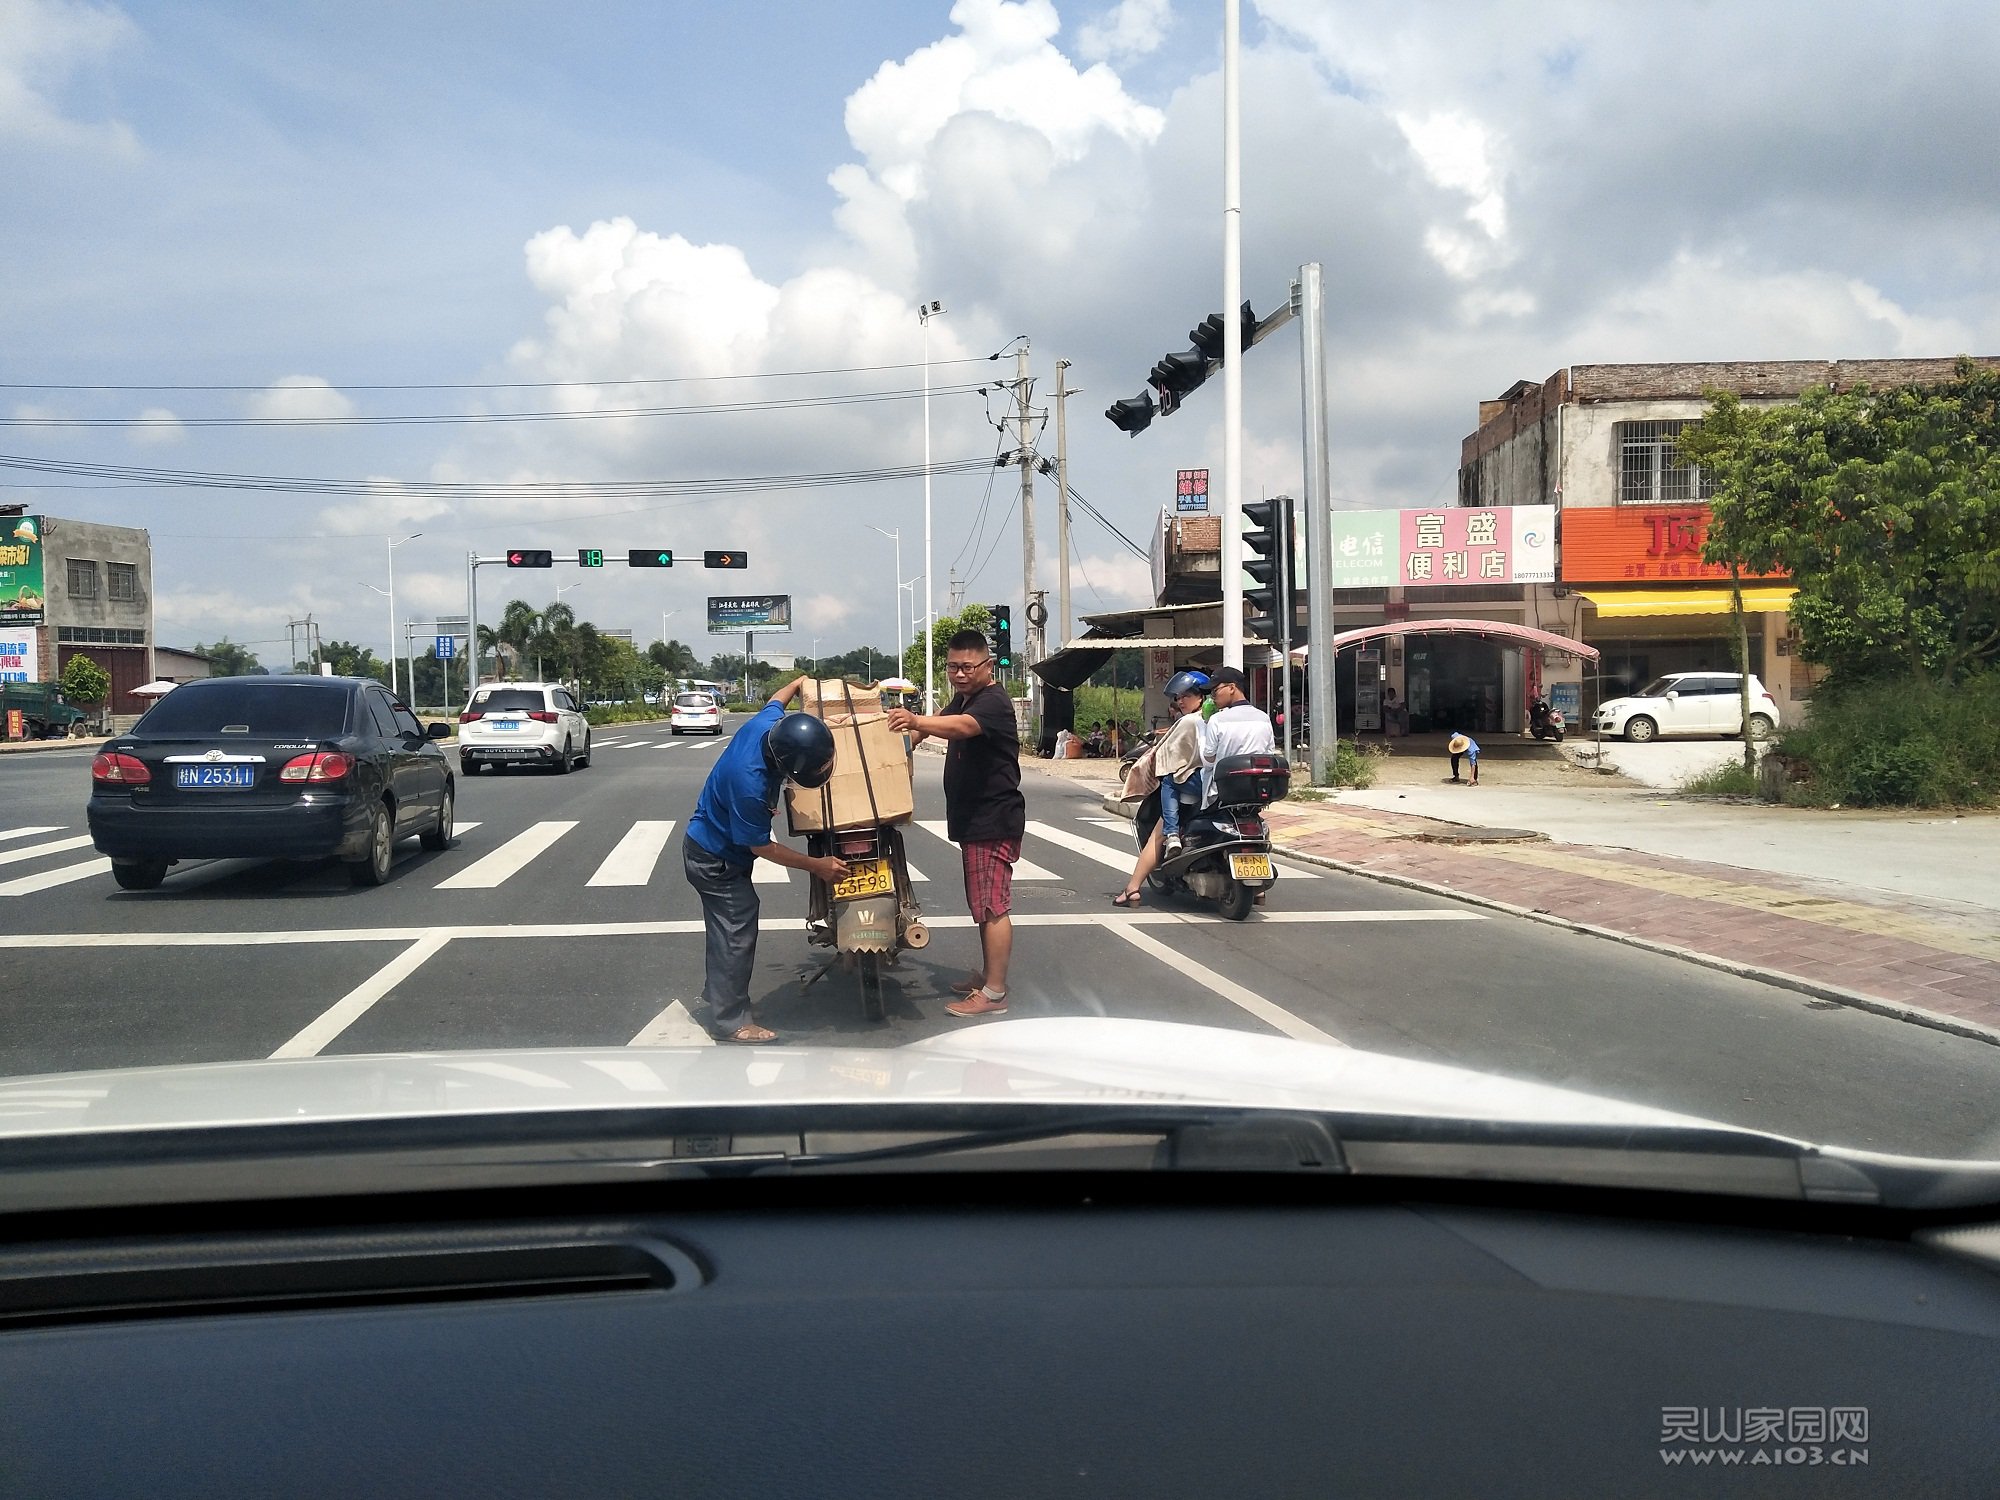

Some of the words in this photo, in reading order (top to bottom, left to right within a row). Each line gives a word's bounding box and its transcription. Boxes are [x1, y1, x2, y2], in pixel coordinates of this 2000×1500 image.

[1178, 479, 1208, 495] 维修
[1415, 511, 1498, 549] 富盛
[1340, 531, 1385, 556] 电信
[587, 550, 602, 566] 18
[1406, 550, 1506, 580] 便利店
[1237, 866, 1269, 877] 6G200
[837, 874, 888, 896] 63F98
